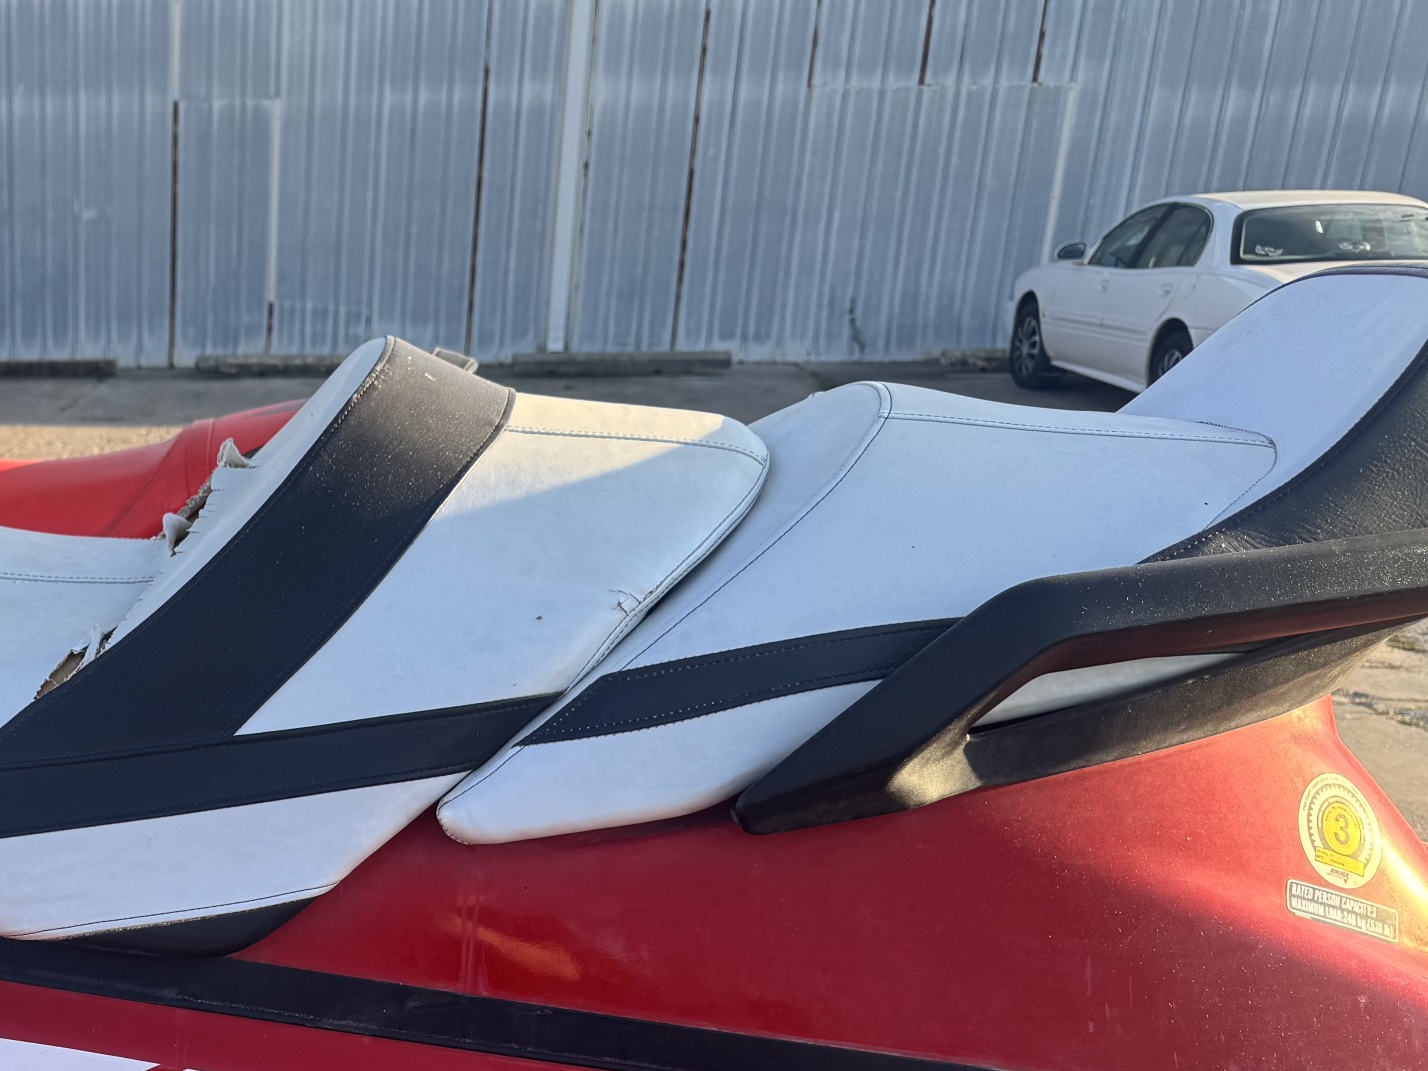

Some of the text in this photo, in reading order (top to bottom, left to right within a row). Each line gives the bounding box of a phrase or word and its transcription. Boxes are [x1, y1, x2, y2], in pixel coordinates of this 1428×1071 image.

[1334, 813, 1350, 845] 3
[1291, 882, 1314, 899] RATED
[1314, 888, 1341, 907] PERSON
[1291, 897, 1325, 916] MAXIMUM
